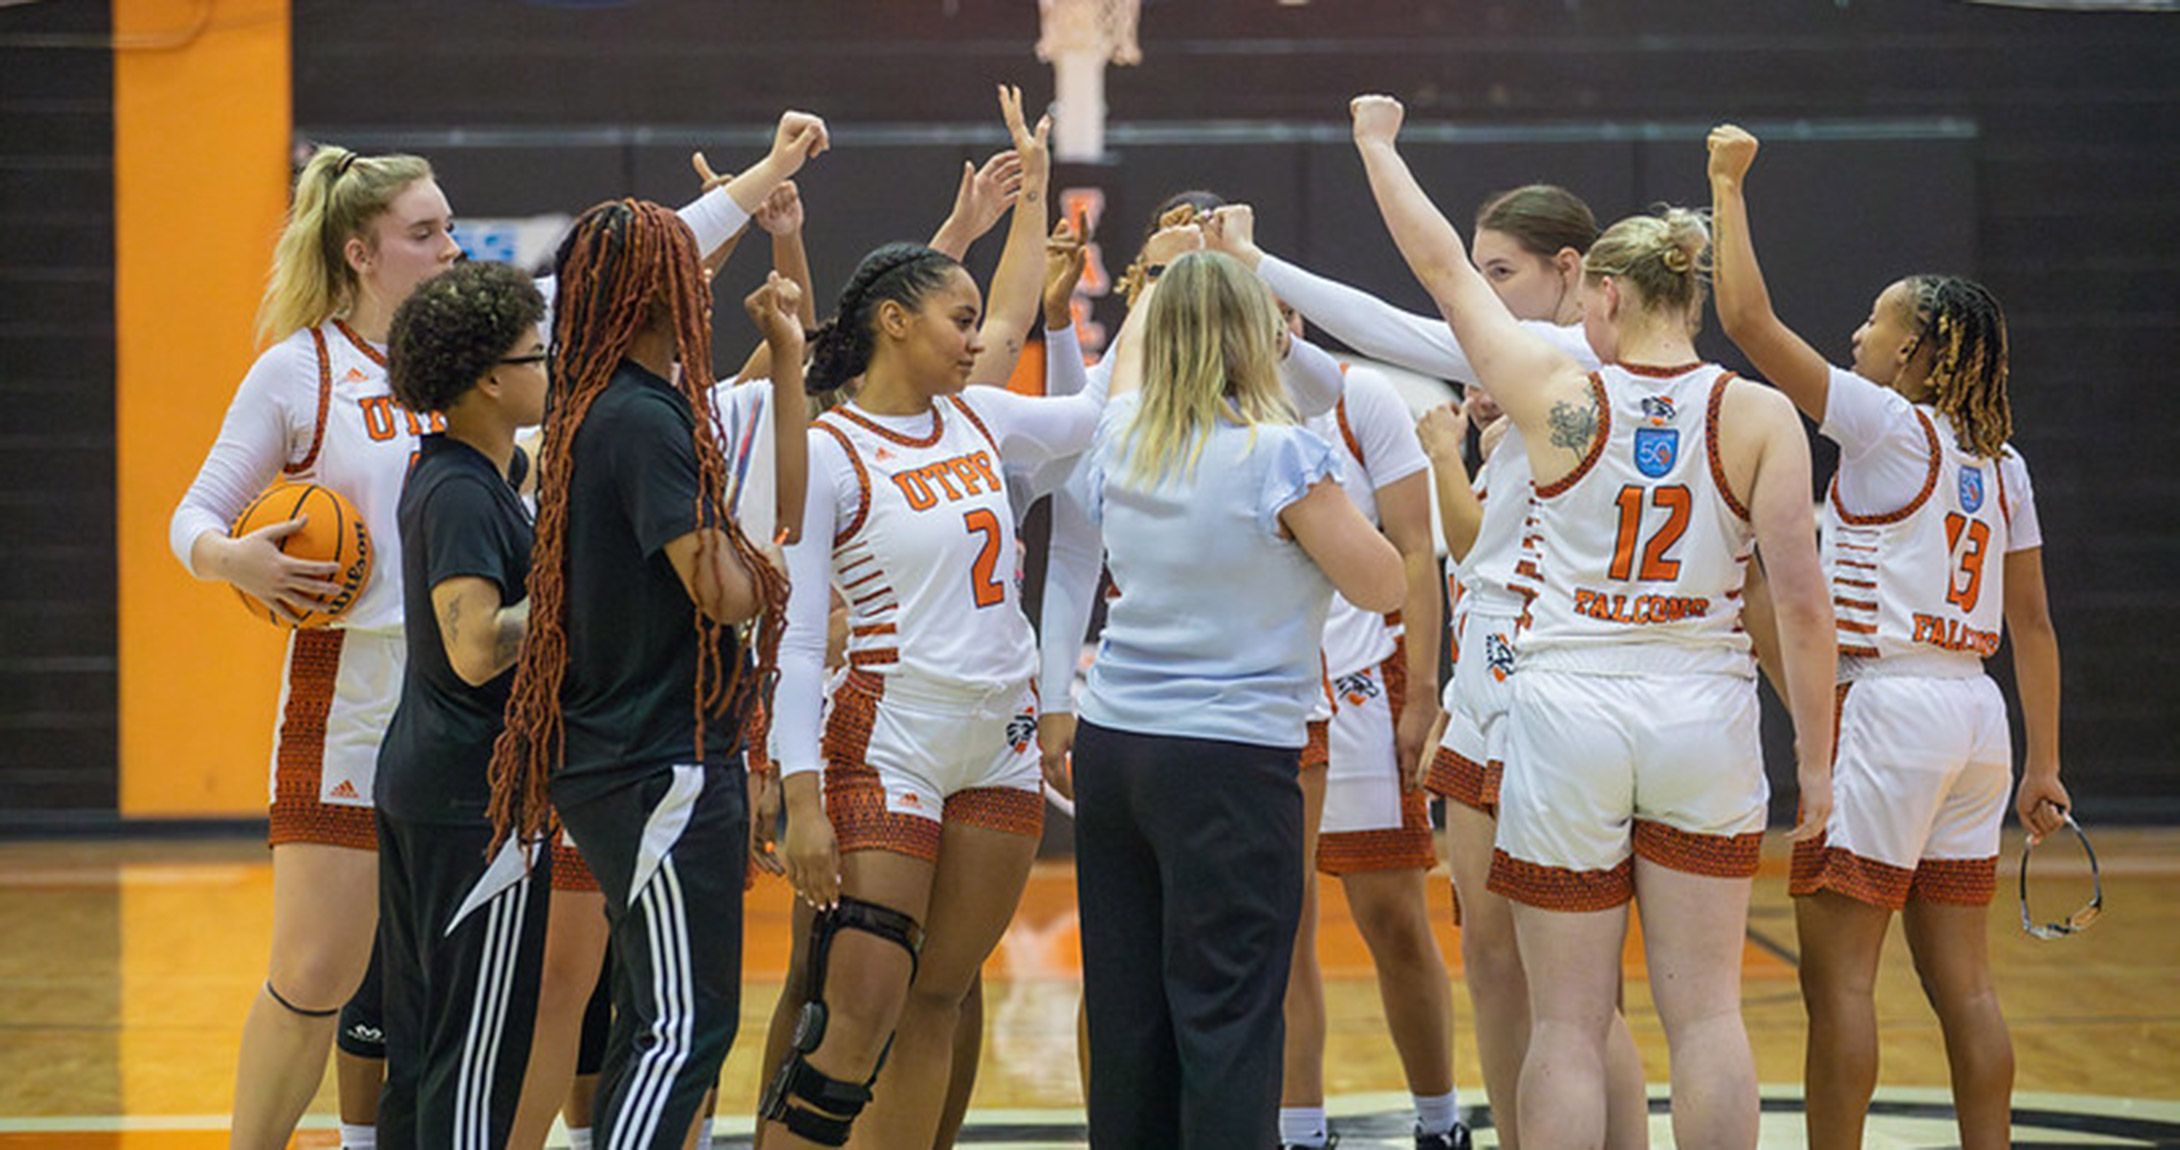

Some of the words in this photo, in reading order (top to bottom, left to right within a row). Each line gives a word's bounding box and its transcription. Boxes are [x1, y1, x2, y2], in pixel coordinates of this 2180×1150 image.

[963, 508, 1005, 609] 2
[1608, 483, 1692, 582] 12
[1944, 511, 1990, 614] 13
